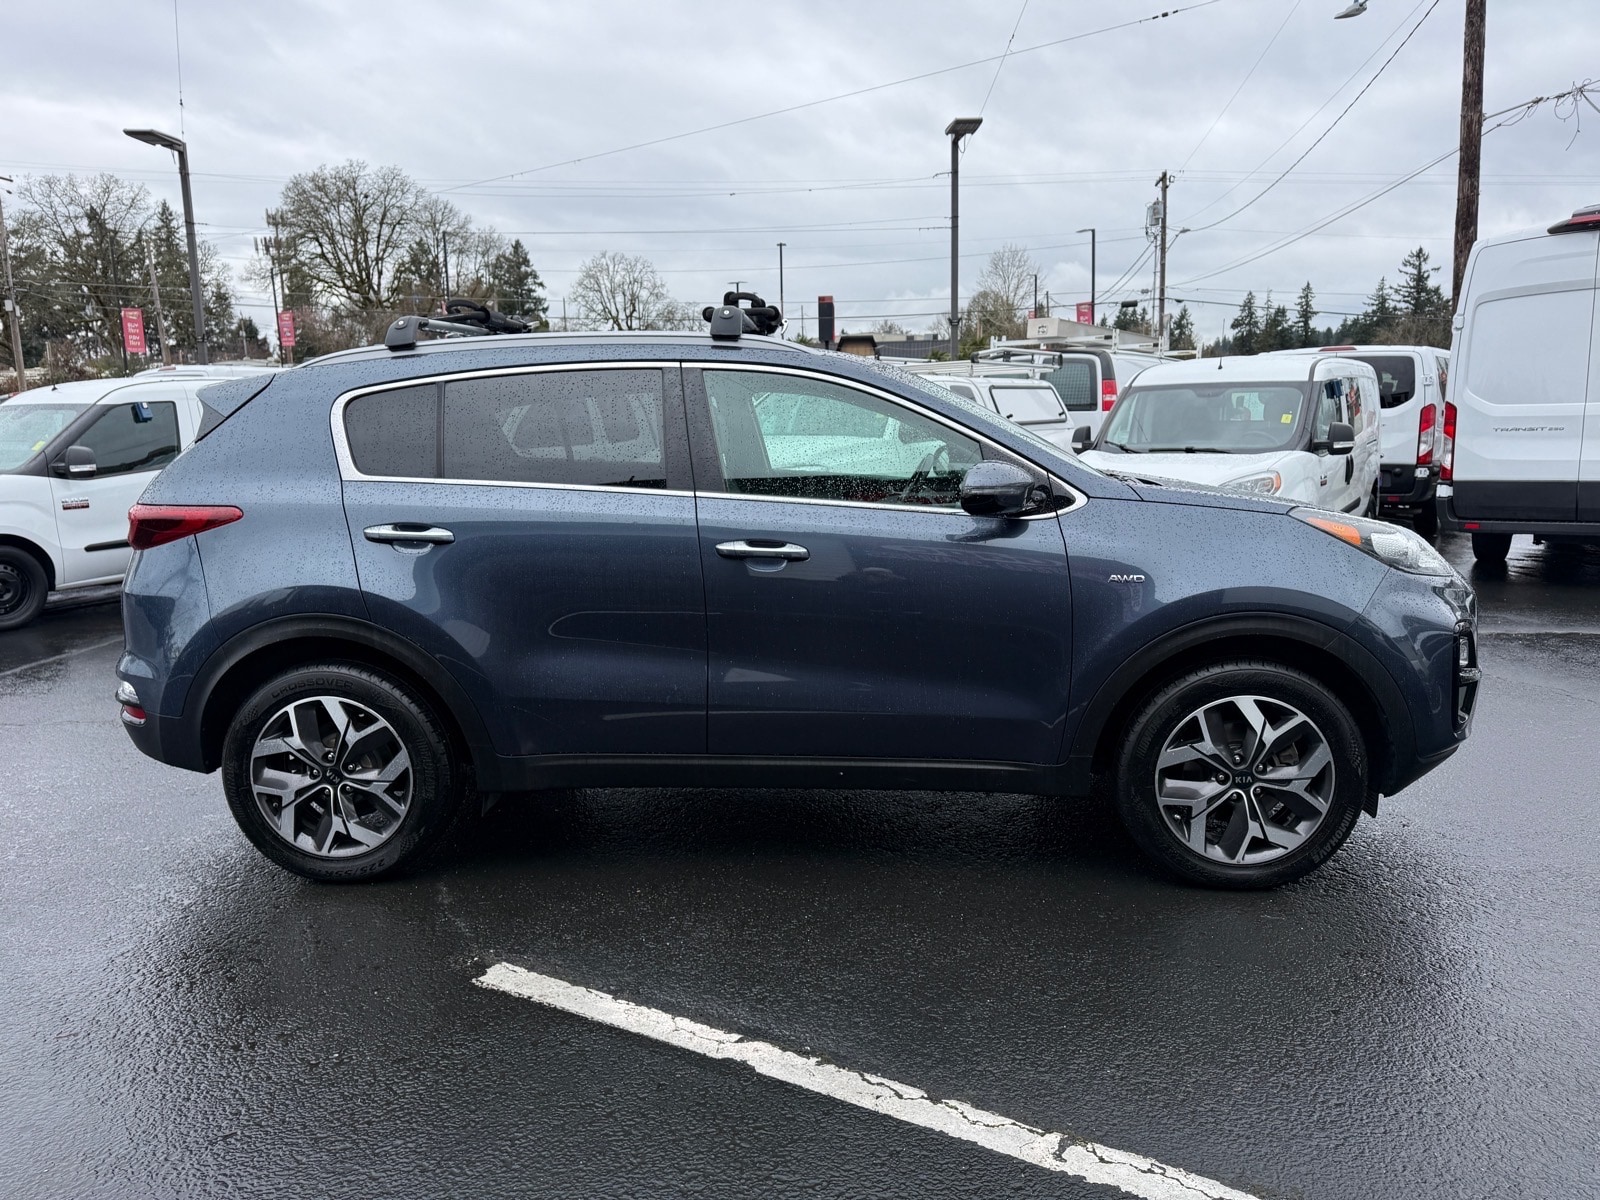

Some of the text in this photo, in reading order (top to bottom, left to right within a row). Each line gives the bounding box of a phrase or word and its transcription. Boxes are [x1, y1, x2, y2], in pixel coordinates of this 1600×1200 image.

[1107, 574, 1146, 583] AWD
[272, 678, 354, 698] CROSSOVER
[326, 769, 341, 784] KIA
[1235, 776, 1253, 784] KIA
[1312, 817, 1350, 864] MOHAVE
